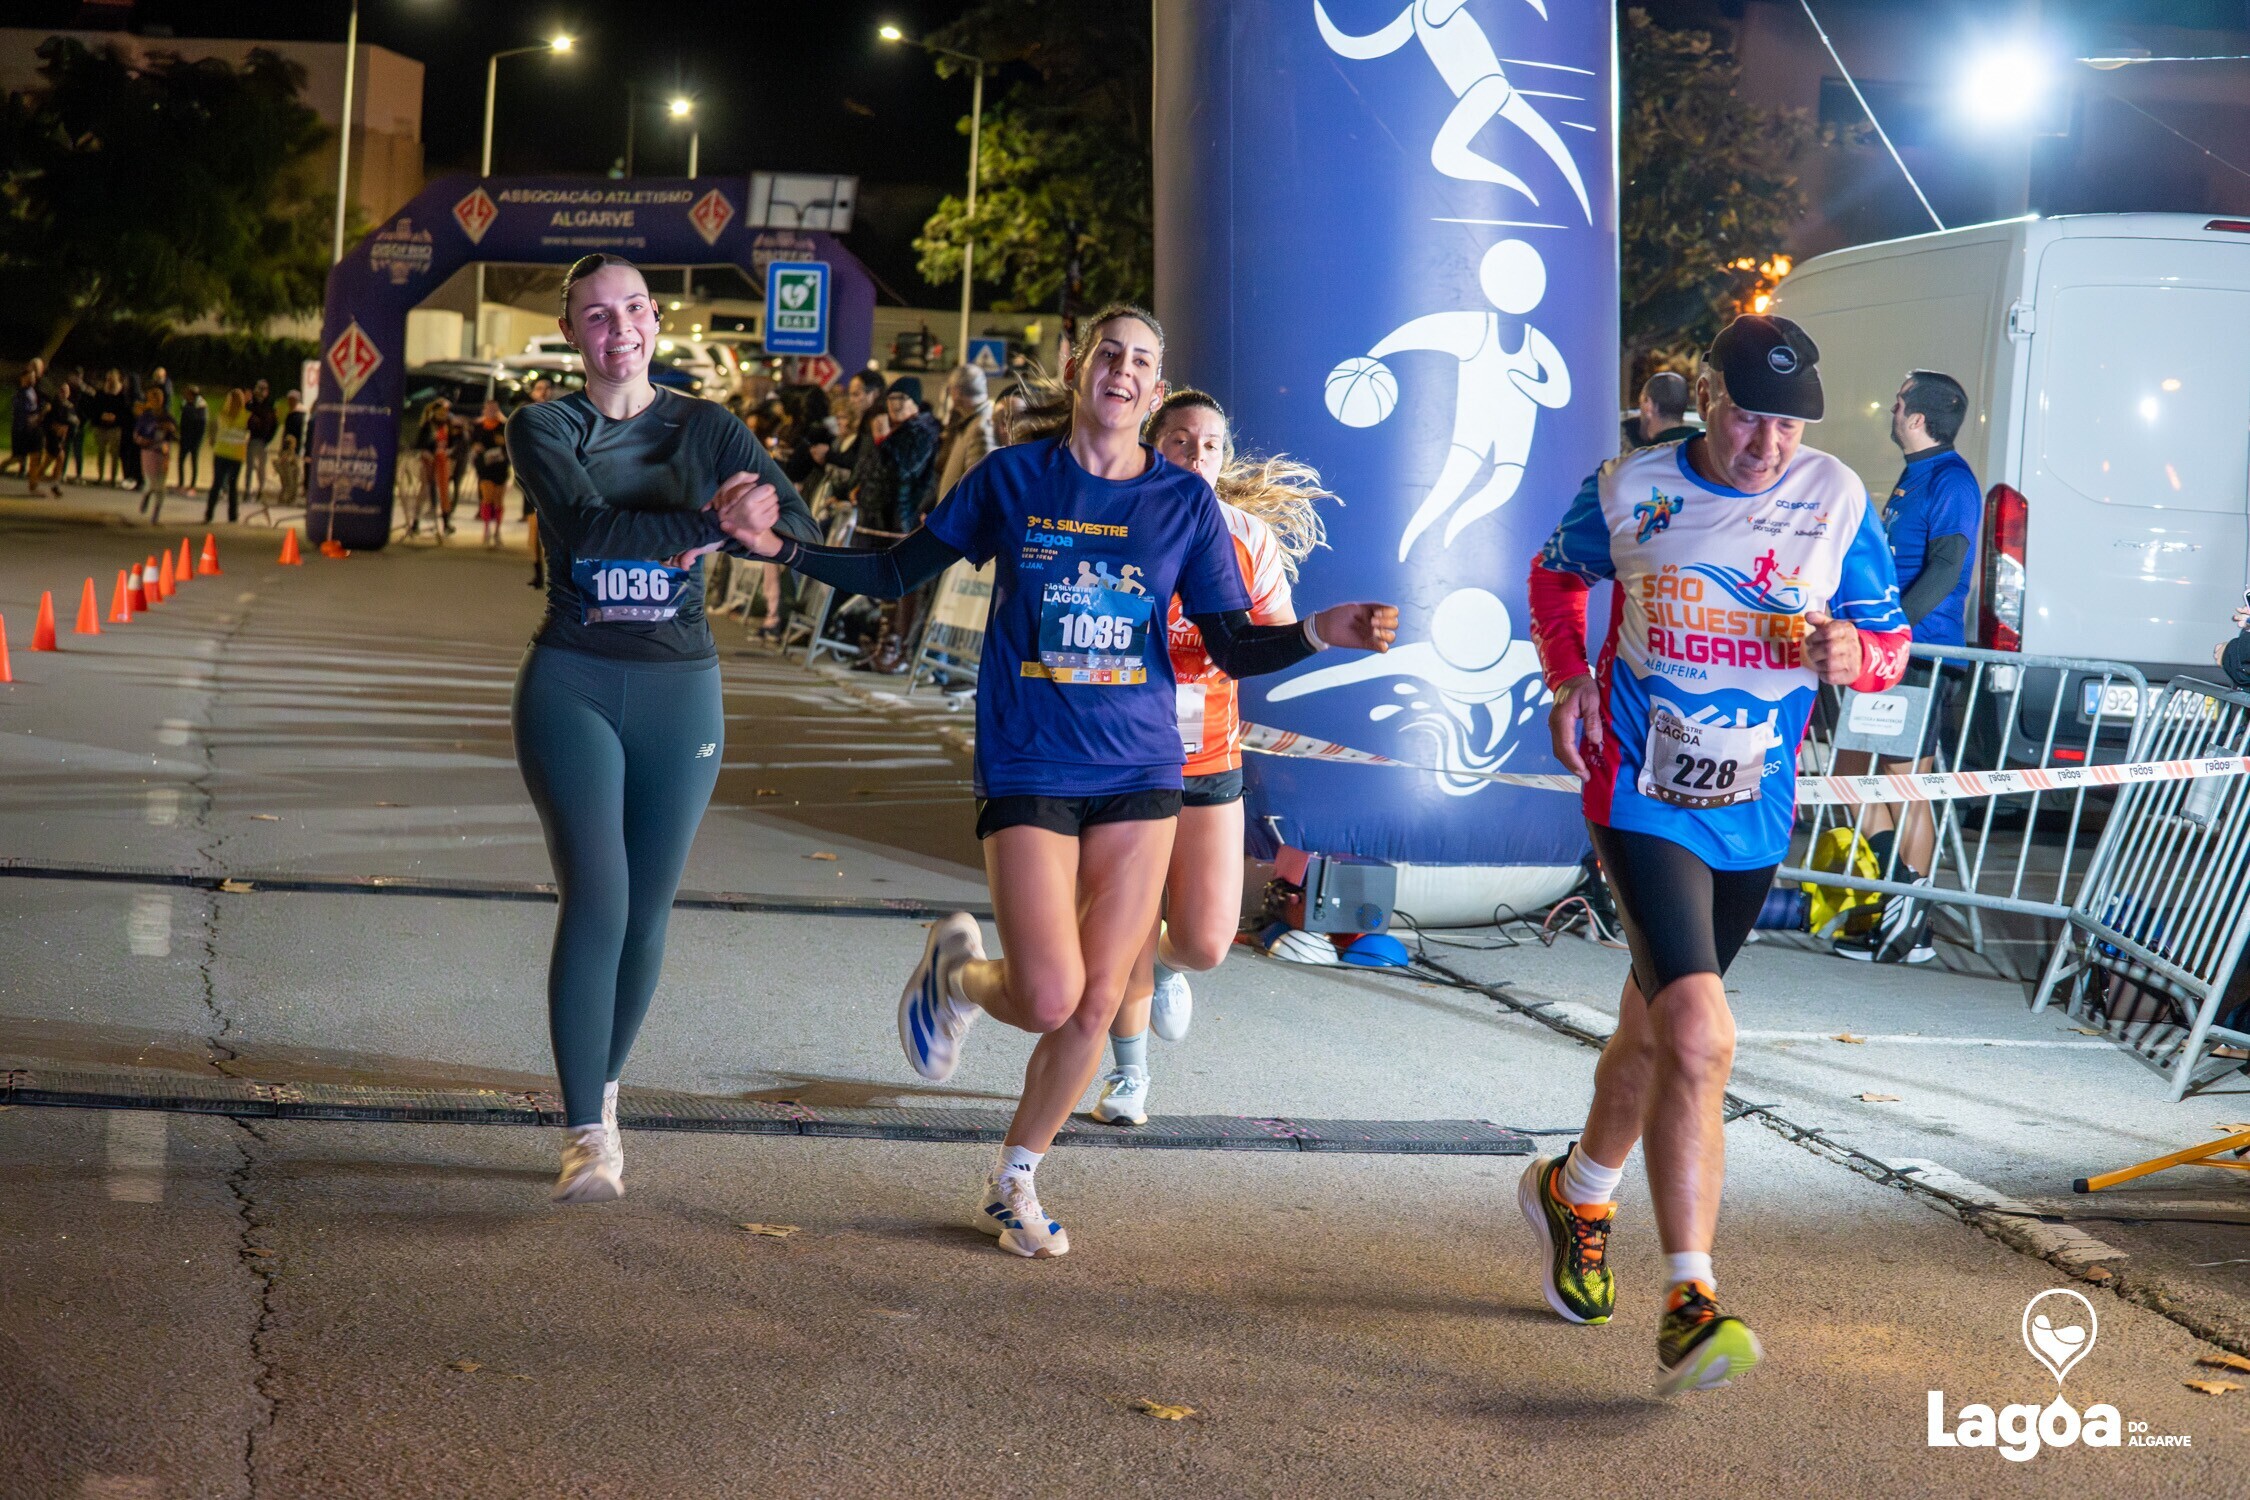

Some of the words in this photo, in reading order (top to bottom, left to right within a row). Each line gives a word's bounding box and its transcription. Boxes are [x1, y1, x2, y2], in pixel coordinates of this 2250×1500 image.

[604, 189, 694, 204] ATLETISMO
[549, 209, 635, 228] ALGARVE
[1042, 518, 1055, 530] S.
[1056, 519, 1129, 537] SILVESTRE
[1025, 529, 1074, 548] Lagoa
[1025, 561, 1044, 570] JAN.
[592, 567, 670, 601] 1036
[1642, 564, 1704, 603] SÃO
[1043, 590, 1091, 605] LAGOA
[1058, 613, 1134, 649] 1035
[1643, 657, 1708, 681] ALBUFEIRA
[1656, 720, 1701, 747] LAGOA
[1672, 753, 1738, 790] 228
